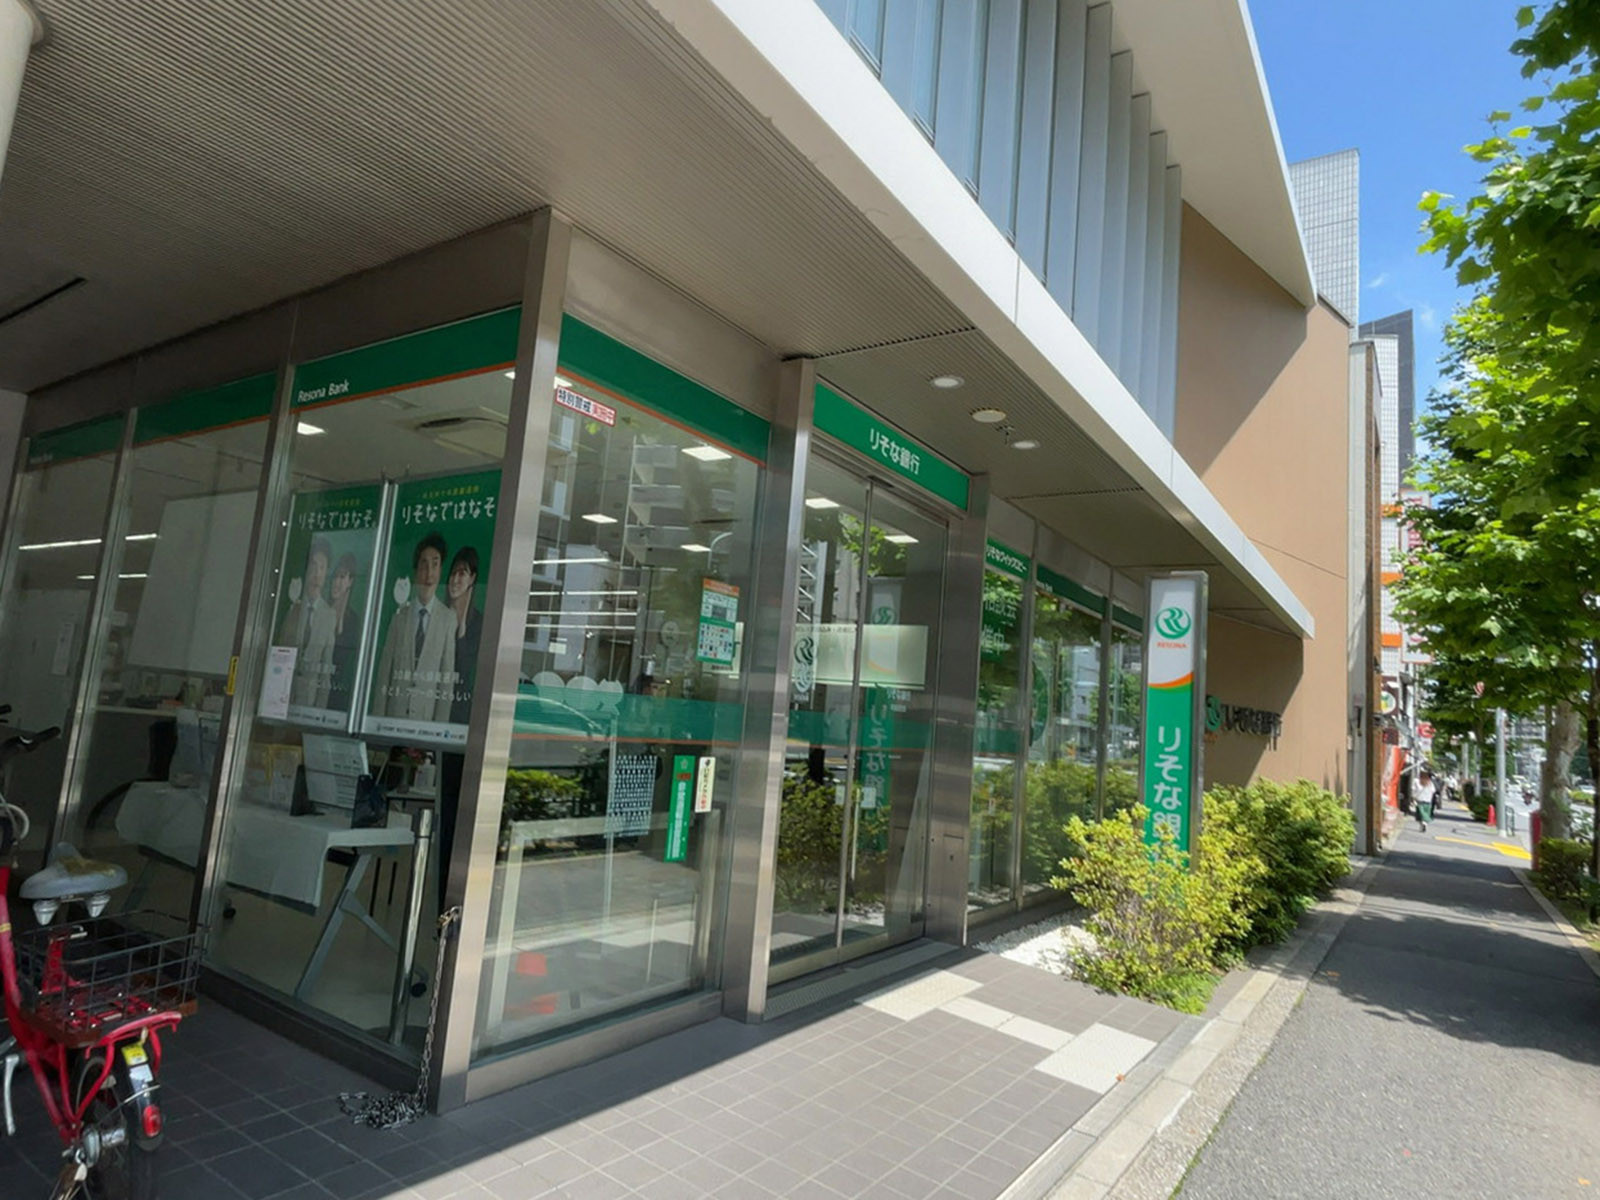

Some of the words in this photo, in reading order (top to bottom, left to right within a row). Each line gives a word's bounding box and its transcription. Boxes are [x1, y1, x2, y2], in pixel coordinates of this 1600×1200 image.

[298, 389, 326, 402] Resona
[328, 379, 350, 396] Bank
[870, 428, 920, 475] りそな銀行
